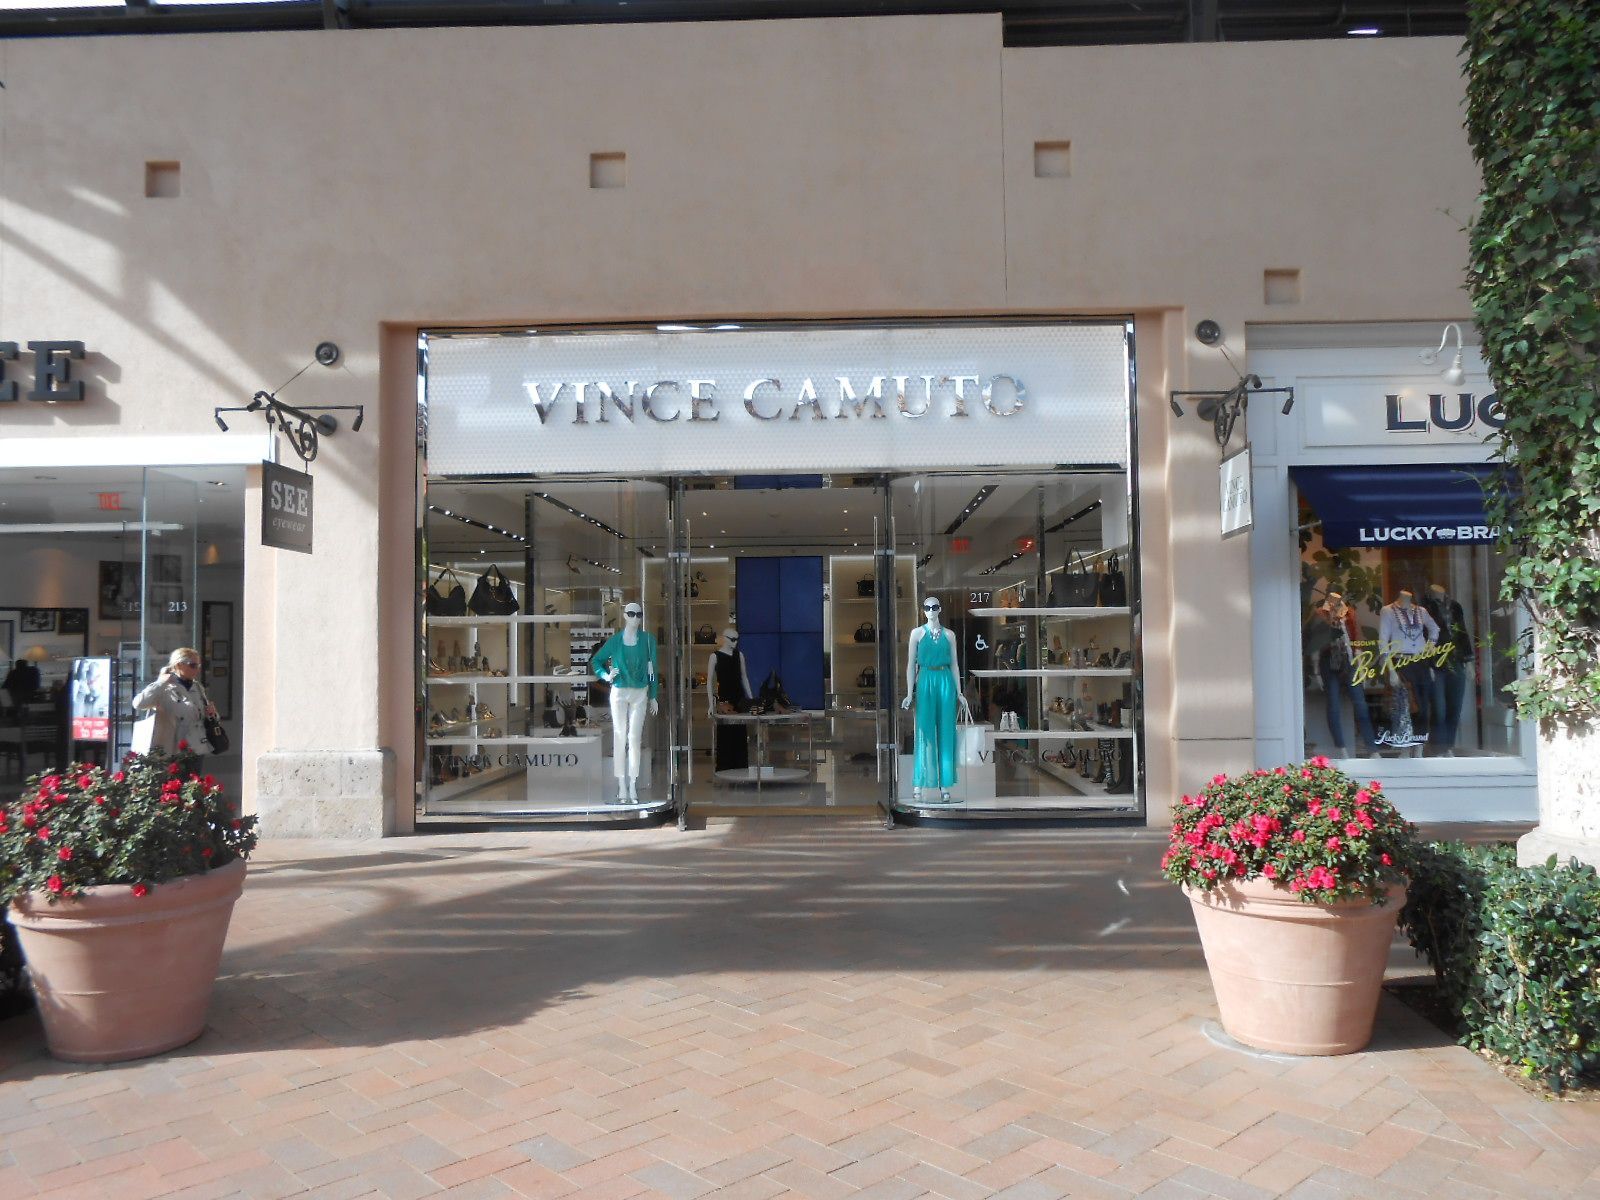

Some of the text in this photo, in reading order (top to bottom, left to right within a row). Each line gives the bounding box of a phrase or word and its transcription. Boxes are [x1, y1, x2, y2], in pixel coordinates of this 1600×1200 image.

[522, 374, 1026, 424] VINCE CAMUTO
[270, 480, 308, 517] SEE
[272, 517, 305, 532] eyewear
[1359, 526, 1437, 541] LUCKY
[970, 592, 990, 603] 217
[168, 601, 188, 612] 213
[1350, 651, 1376, 687] Be
[498, 753, 579, 768] CAMUTO
